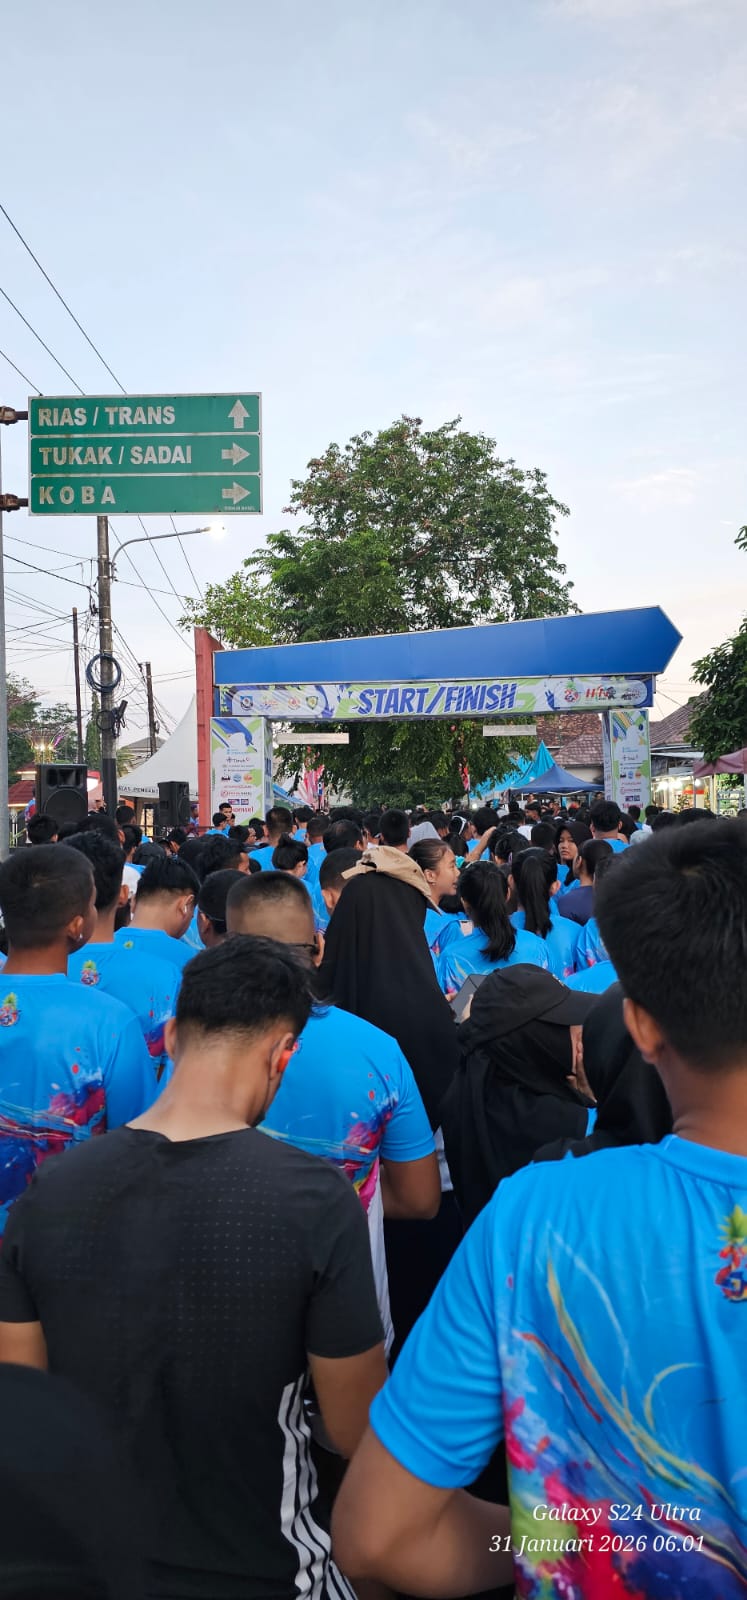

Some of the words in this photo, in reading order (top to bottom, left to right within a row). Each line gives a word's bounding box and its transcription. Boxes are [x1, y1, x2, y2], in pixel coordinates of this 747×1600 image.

[38, 407, 88, 427] RIAS
[92, 407, 99, 427] /
[104, 405, 176, 426] TRANS
[38, 446, 114, 466] TUKAK
[117, 446, 125, 465] /
[130, 445, 193, 465] SADAI
[357, 682, 518, 715] START/FINISH
